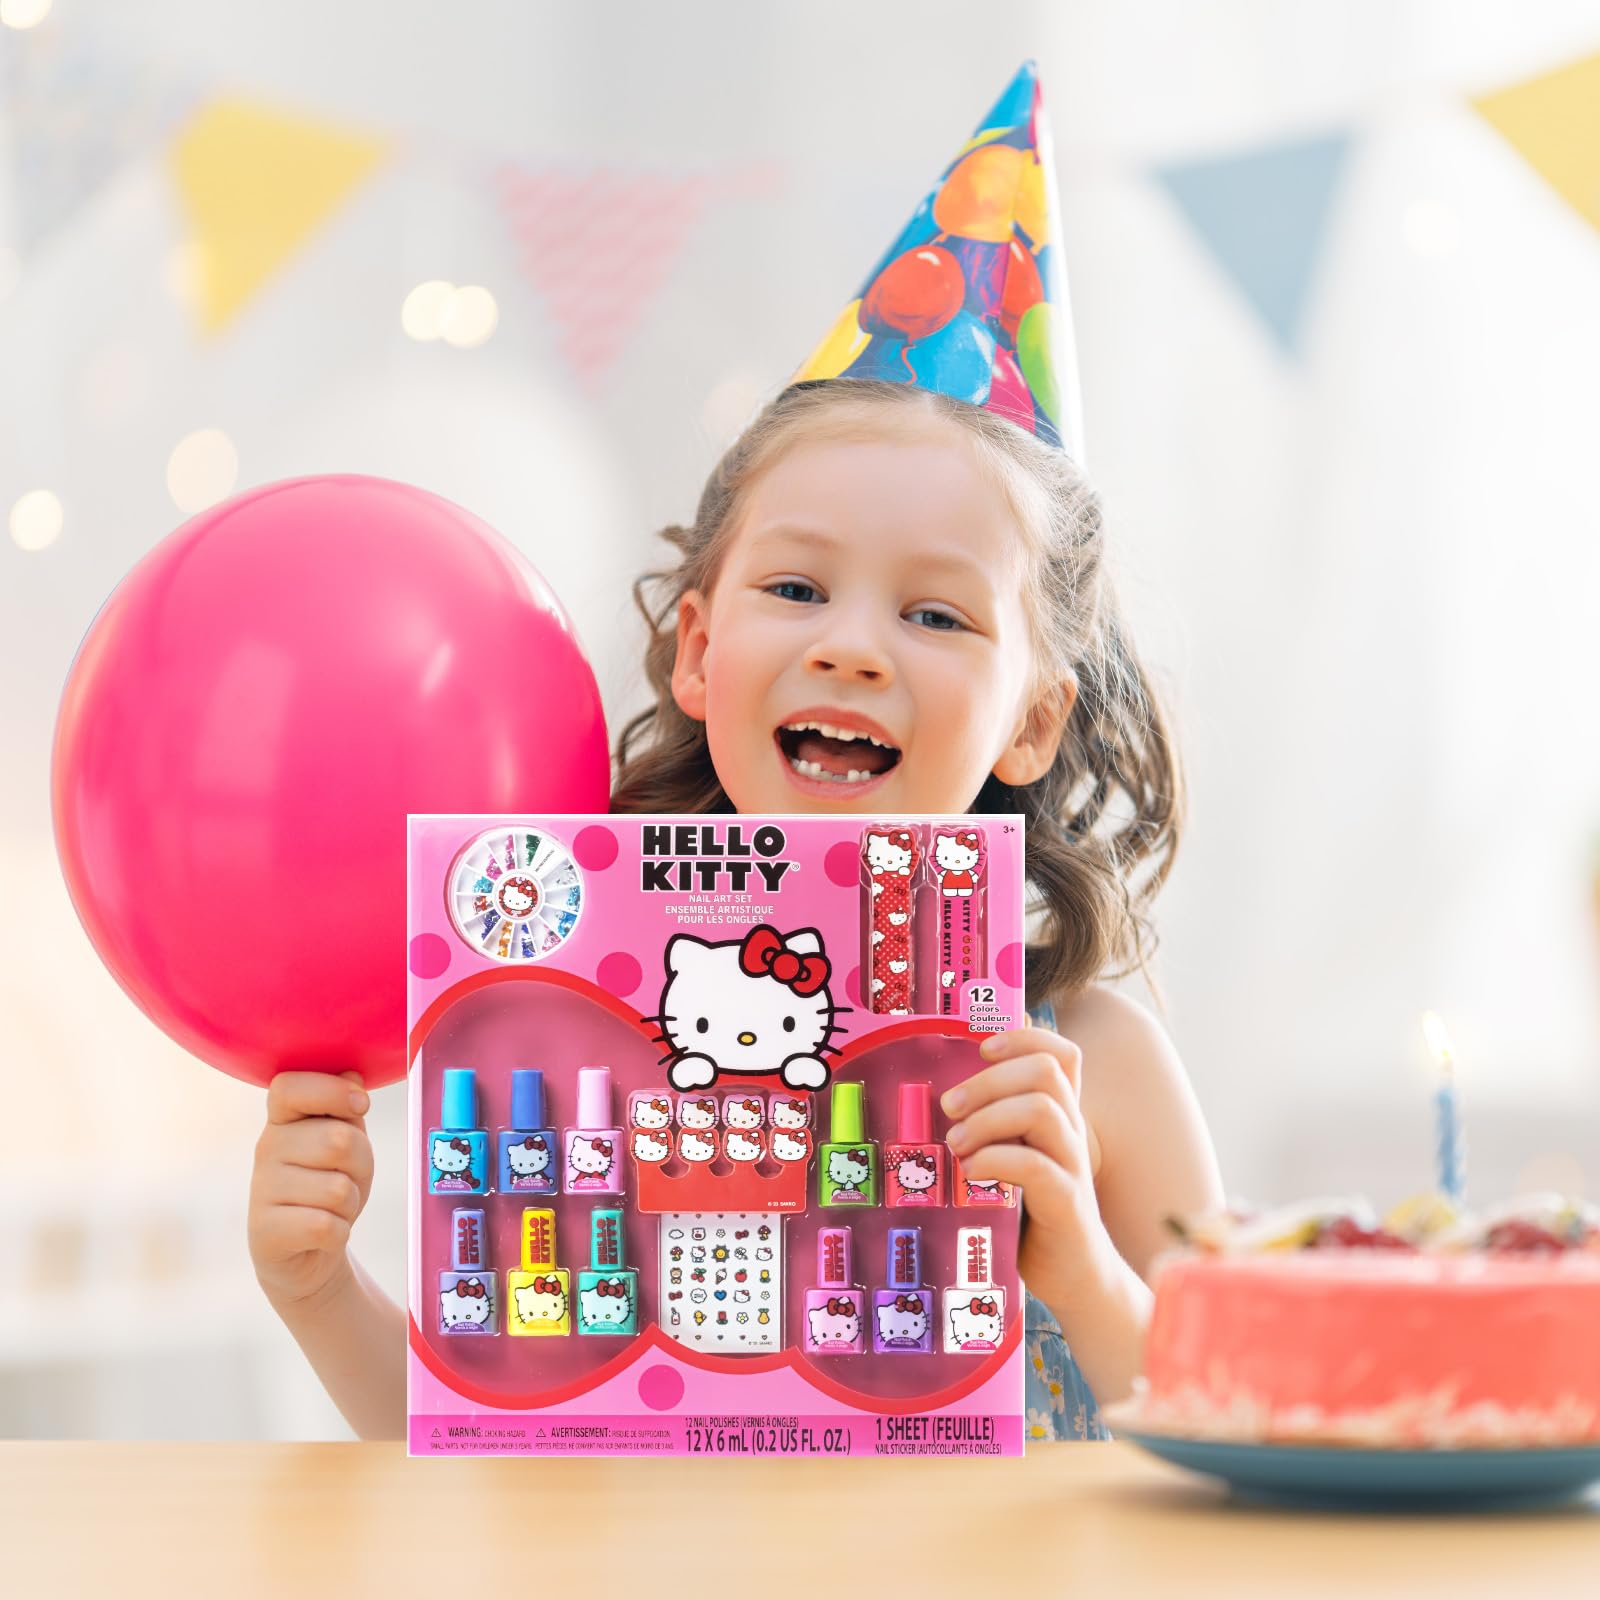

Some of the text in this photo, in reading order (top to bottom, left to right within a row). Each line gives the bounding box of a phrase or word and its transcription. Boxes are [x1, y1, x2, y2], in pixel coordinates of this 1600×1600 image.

[642, 825, 786, 858] HELLO
[1003, 826, 1015, 834] 3+
[665, 906, 774, 914] ENSEMBLE ARTISTIQUE
[678, 916, 764, 924] POUR LES ONGLES
[970, 988, 994, 1002] 12
[969, 1014, 1011, 1022] Couleurs
[969, 1024, 1006, 1032] Colores
[458, 1217, 468, 1264] HELLO
[468, 1216, 480, 1264] KITTY
[529, 1216, 540, 1264] HELLO
[540, 1216, 550, 1264] KITTY
[596, 1218, 607, 1264] HELLO
[607, 1216, 618, 1264] KITTY
[824, 1236, 834, 1282] HELLO
[834, 1234, 844, 1282] KITTY
[895, 1236, 905, 1282] HELLO
[905, 1235, 915, 1282] KITTY
[968, 1236, 978, 1282] HELLO
[978, 1234, 988, 1282] KITTY
[551, 1427, 611, 1438] AVERTISSEMENT:
[685, 1417, 693, 1428] 12
[694, 1417, 708, 1428] NAIL
[710, 1417, 739, 1428] POLISHES
[740, 1417, 765, 1428] (VERNIS
[772, 1417, 799, 1428] ONGLES)
[686, 1429, 850, 1455] 12 X 6 mL (0.2 US FL. OZ.)
[876, 1417, 994, 1444] 1 SHEET (FEUILLE)
[876, 1444, 890, 1454] NAIL
[890, 1444, 916, 1454] STICKER
[916, 1444, 968, 1454] (AUTOCOLLANTS
[974, 1444, 1002, 1454] ONGLES)
